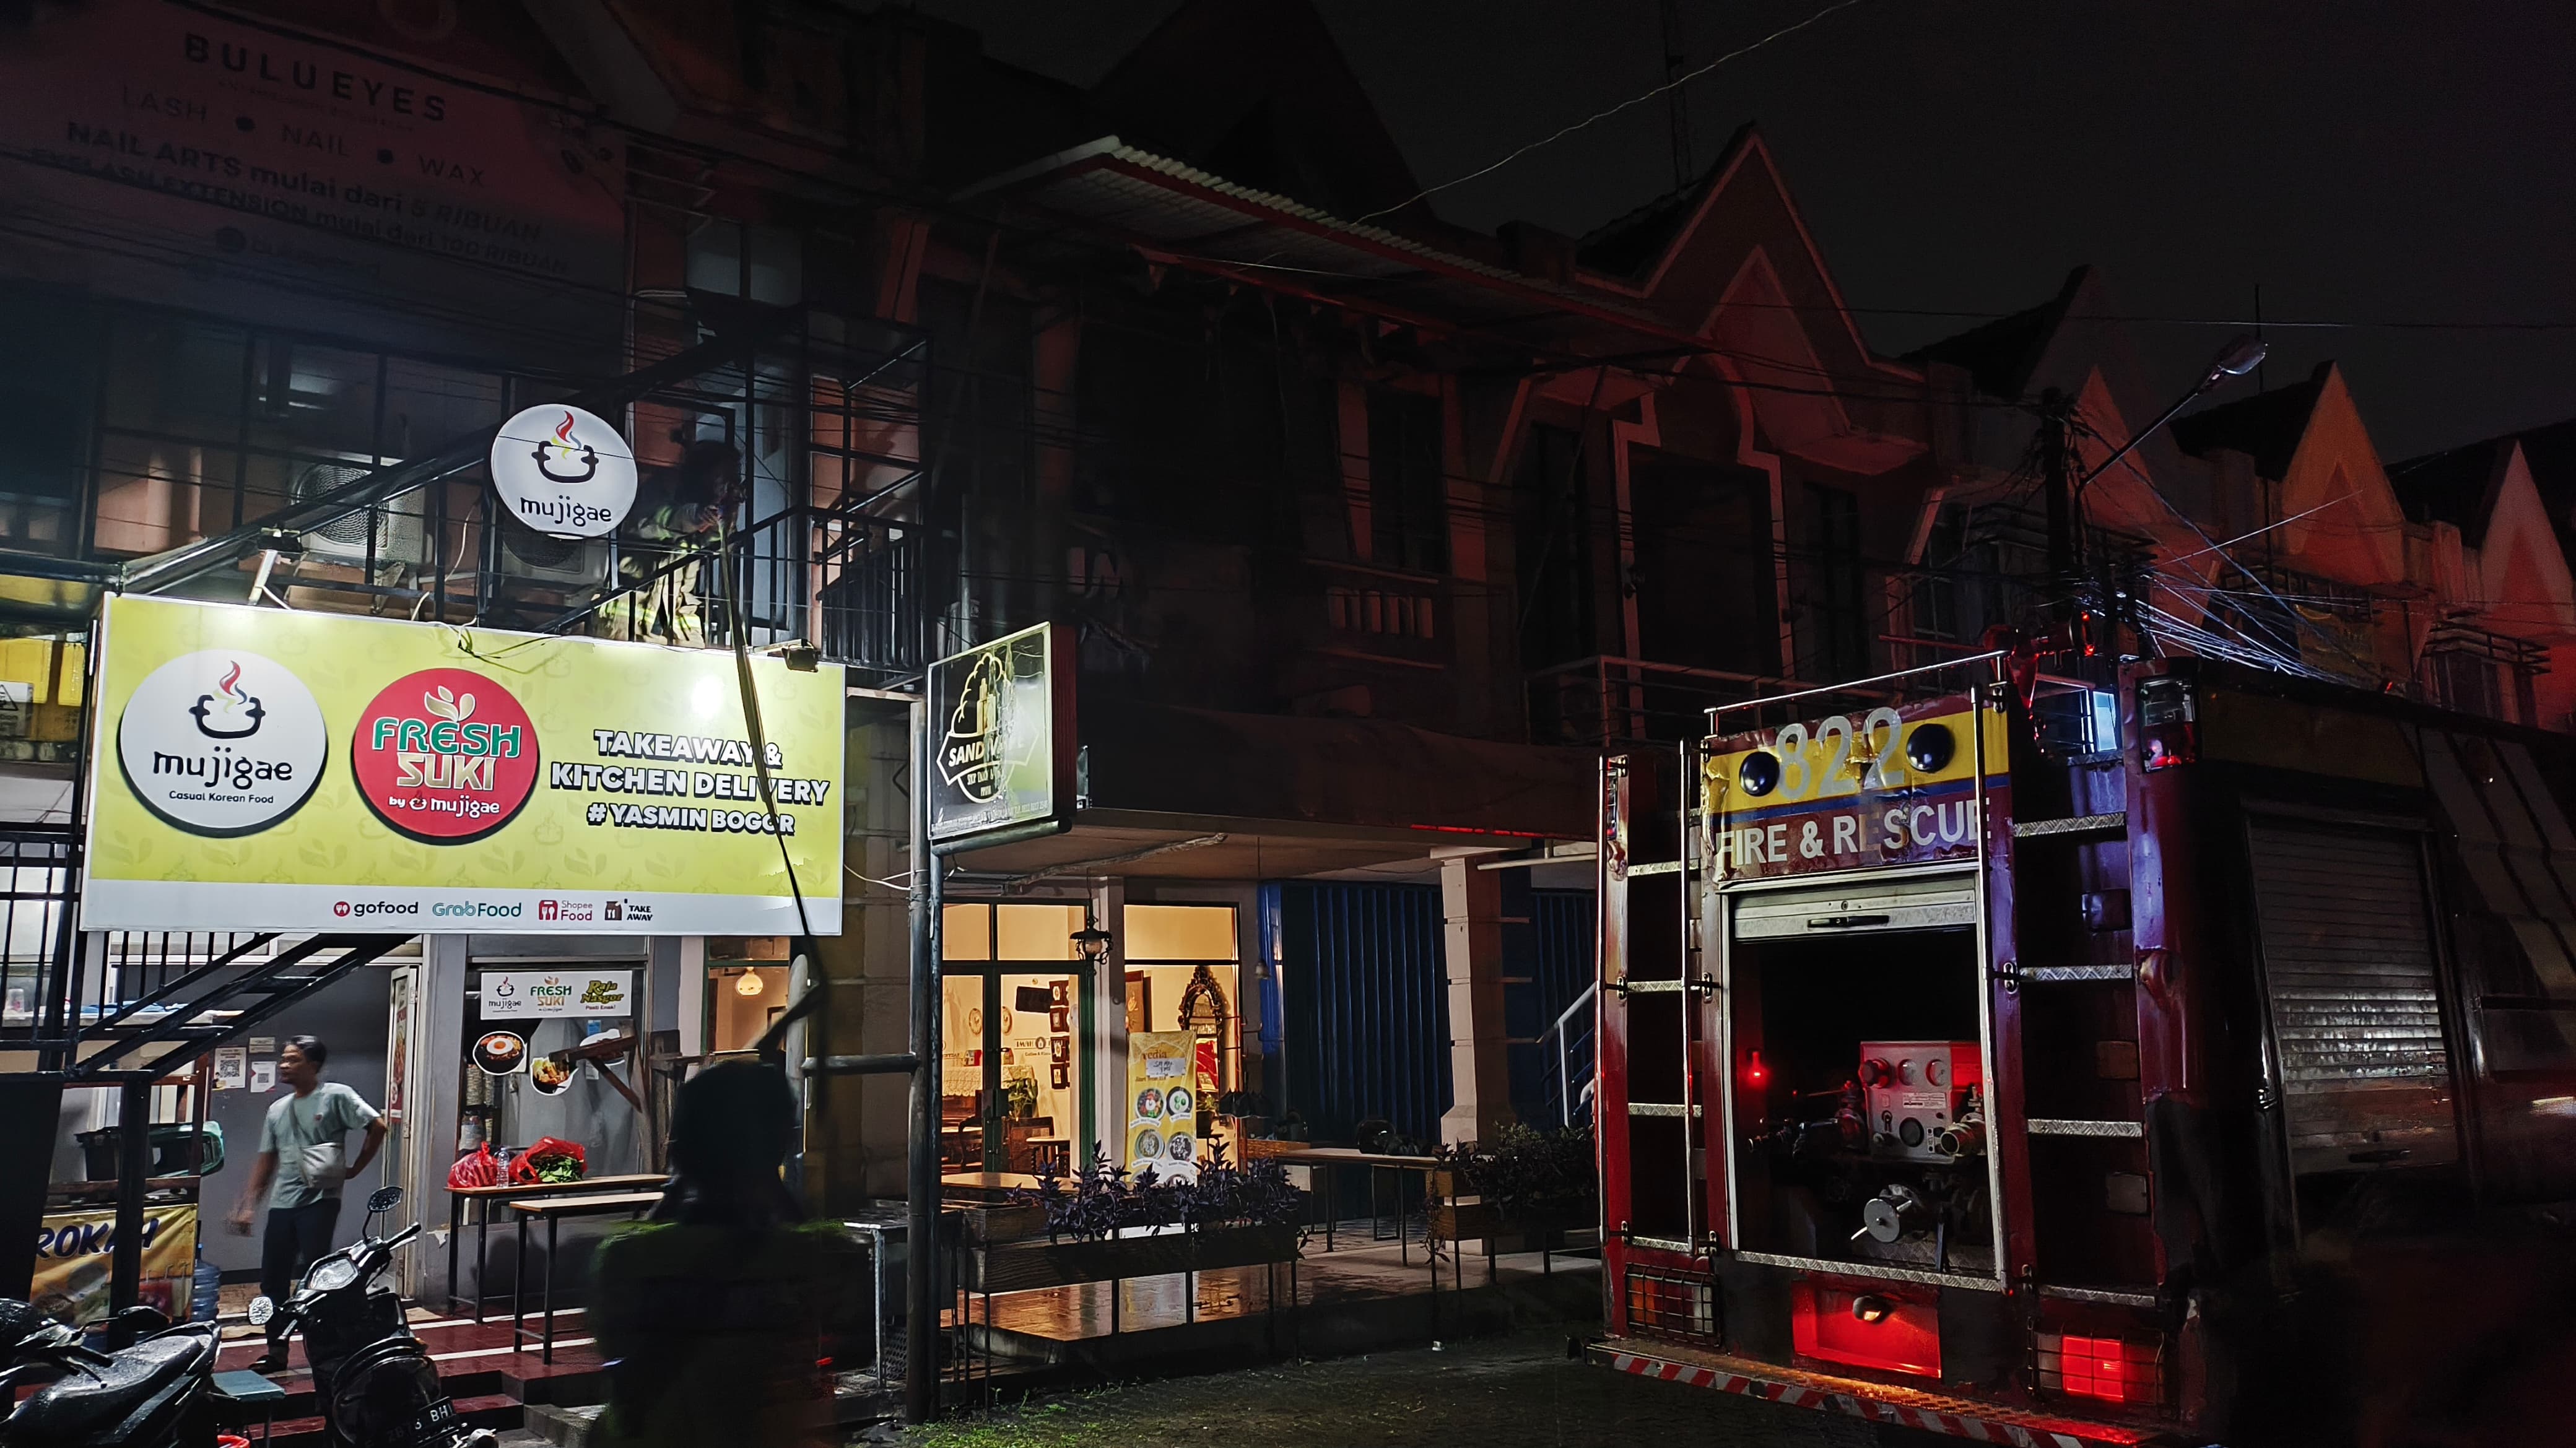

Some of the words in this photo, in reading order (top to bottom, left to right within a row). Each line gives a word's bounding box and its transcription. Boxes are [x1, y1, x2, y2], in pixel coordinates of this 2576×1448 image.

[185, 32, 446, 122] BULUEYES
[123, 85, 207, 123] LASH
[282, 124, 350, 157] NAIL
[419, 154, 485, 186] WAX
[67, 121, 148, 157] NAIL
[155, 142, 242, 178] ARTS
[250, 165, 336, 199] mulai
[344, 178, 402, 214] dari
[436, 204, 541, 242] RIBUAN
[520, 495, 612, 527] mujigae
[372, 717, 522, 758] FRESH
[594, 729, 755, 767] TAKEAWAY
[764, 742, 783, 770] &
[1775, 706, 1906, 800] 822
[153, 745, 293, 791] mujigae
[396, 752, 497, 791] SUKI
[550, 761, 688, 797] KITCHEN
[168, 790, 206, 802] Casual
[209, 792, 246, 804] Korean
[248, 794, 274, 804] Food
[388, 796, 406, 809] by
[430, 795, 500, 819] mujigae
[1715, 823, 1788, 867] FIRE
[1798, 821, 1826, 859] &
[354, 901, 419, 917] gofood
[432, 901, 522, 917] GrabFood
[560, 910, 593, 921] Food
[561, 900, 593, 911] Shopee
[627, 913, 653, 922] AWAY
[628, 904, 651, 914] TAKE
[530, 985, 572, 996] FRESH
[585, 980, 618, 996] Raja
[488, 998, 522, 1010] mujigae
[537, 996, 565, 1007] SUKI
